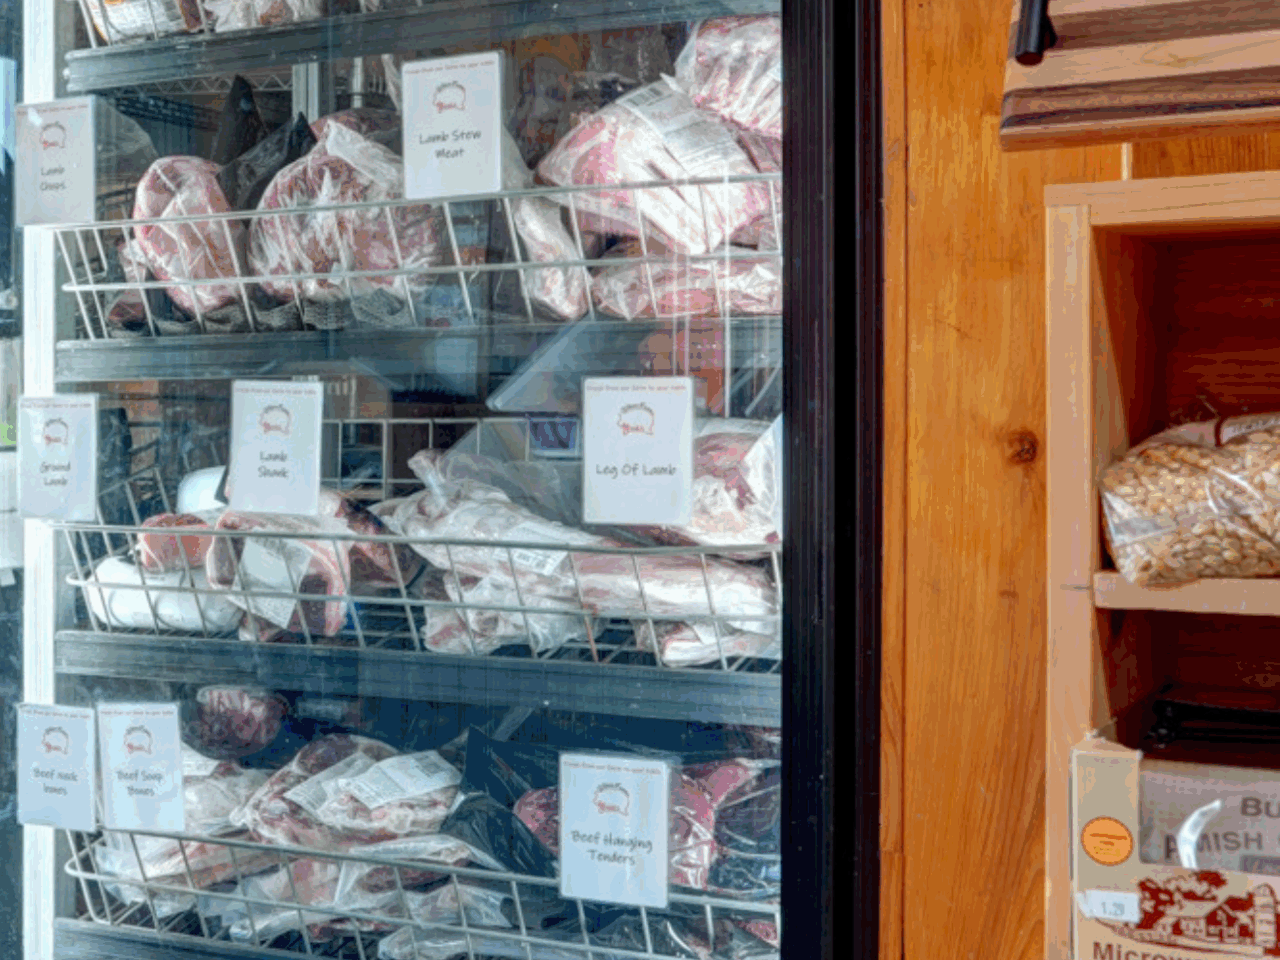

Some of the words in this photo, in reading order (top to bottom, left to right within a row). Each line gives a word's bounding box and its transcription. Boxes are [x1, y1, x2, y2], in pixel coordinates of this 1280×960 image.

[419, 130, 449, 145] Lamb
[451, 128, 481, 142] Stew
[435, 147, 465, 159] Meat
[40, 166, 65, 177] Lamb
[259, 450, 288, 462] Lamb
[40, 460, 71, 474] Ground
[257, 465, 289, 478] Shank
[595, 463, 618, 480] Leg
[620, 462, 640, 476] Of
[642, 462, 677, 476] Lamb
[43, 476, 69, 487] Lamb
[33, 767, 55, 781] Beef
[117, 769, 139, 782] Beef
[141, 770, 163, 783] Soup
[571, 829, 600, 845] Beef
[602, 832, 653, 855] Hanging
[586, 849, 636, 866] Tenders
